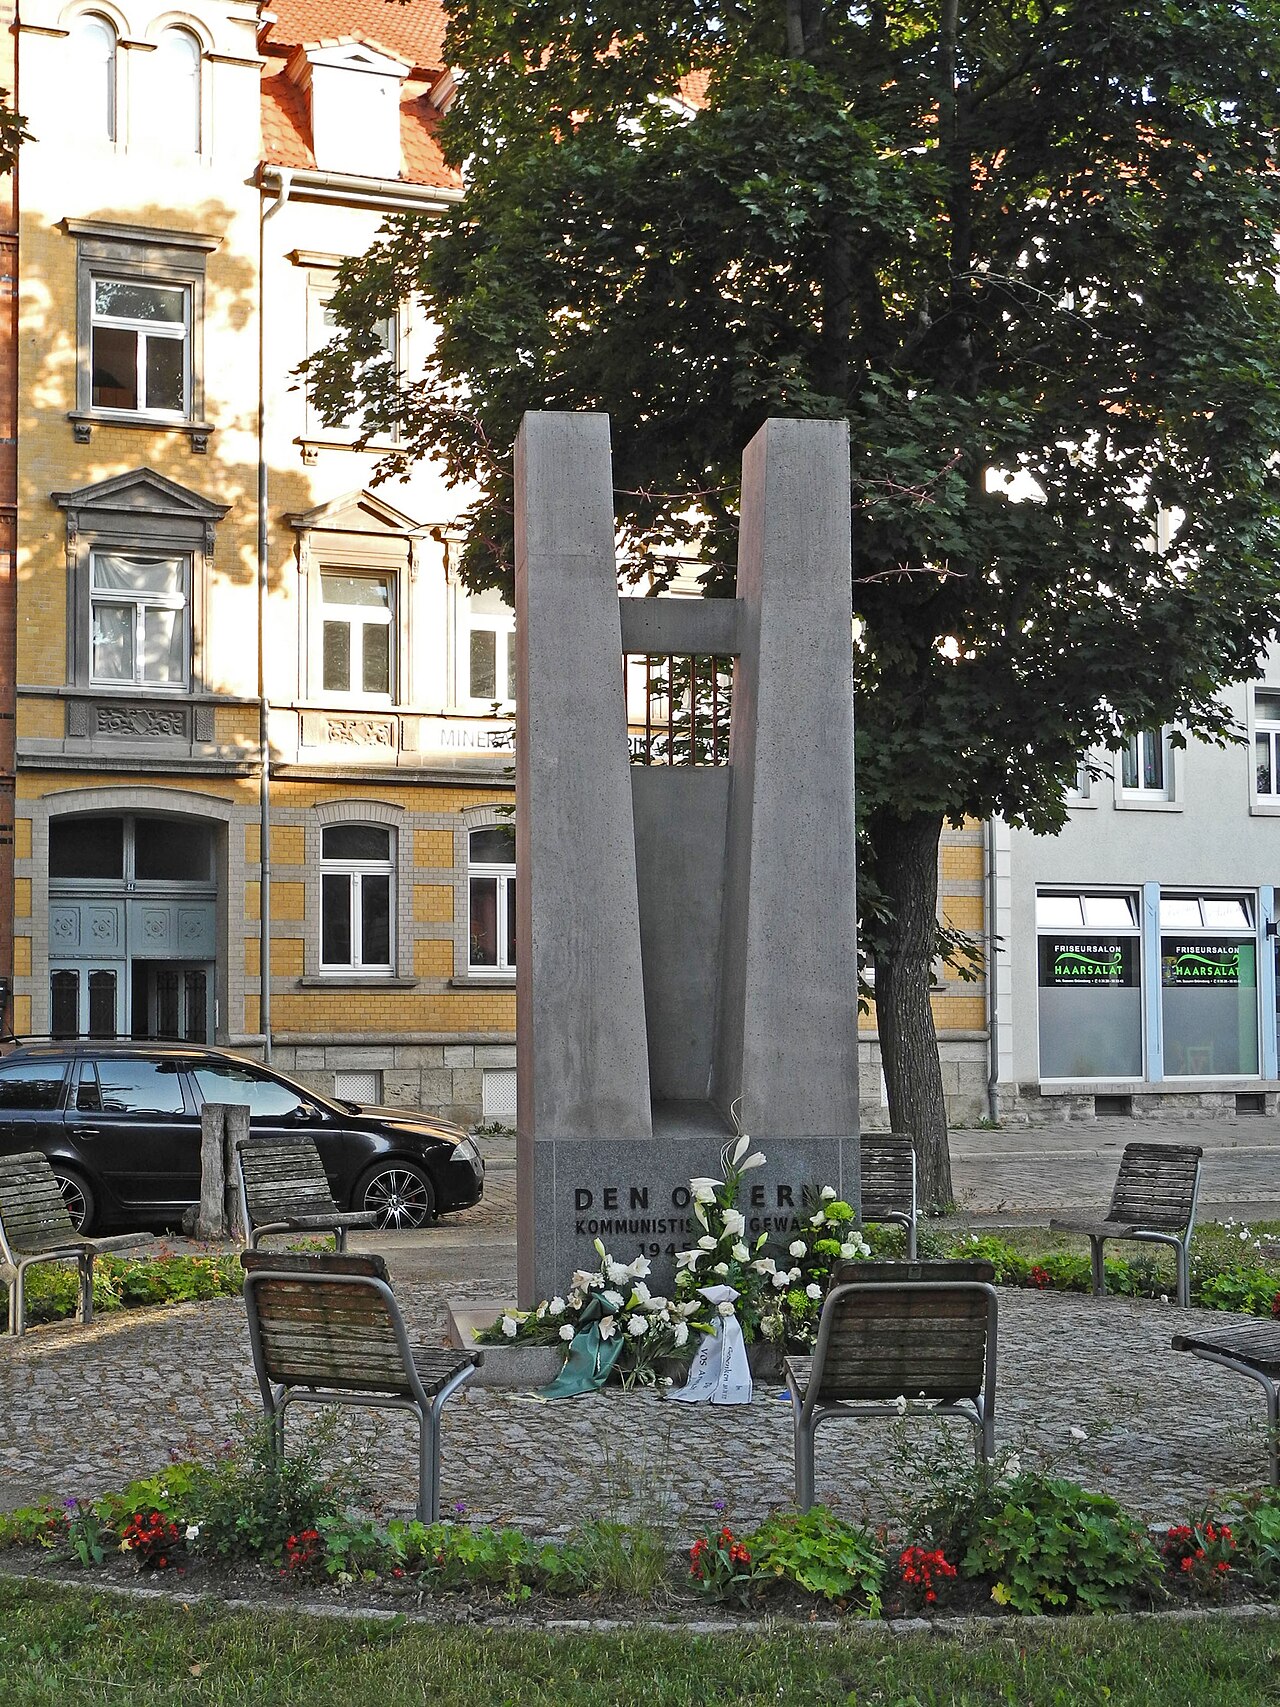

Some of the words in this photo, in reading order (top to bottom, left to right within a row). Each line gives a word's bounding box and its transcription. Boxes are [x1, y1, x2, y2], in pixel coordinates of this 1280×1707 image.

[1054, 945, 1121, 953] FRISEURSALON
[1175, 946, 1240, 954] FRISEURSALON
[1054, 965, 1123, 975] HAARSALAT
[1175, 966, 1240, 976] HAARSALAT
[575, 1187, 649, 1211] DEN
[576, 1218, 696, 1235] KOMMUNISTIS
[750, 1217, 804, 1233] GEWA
